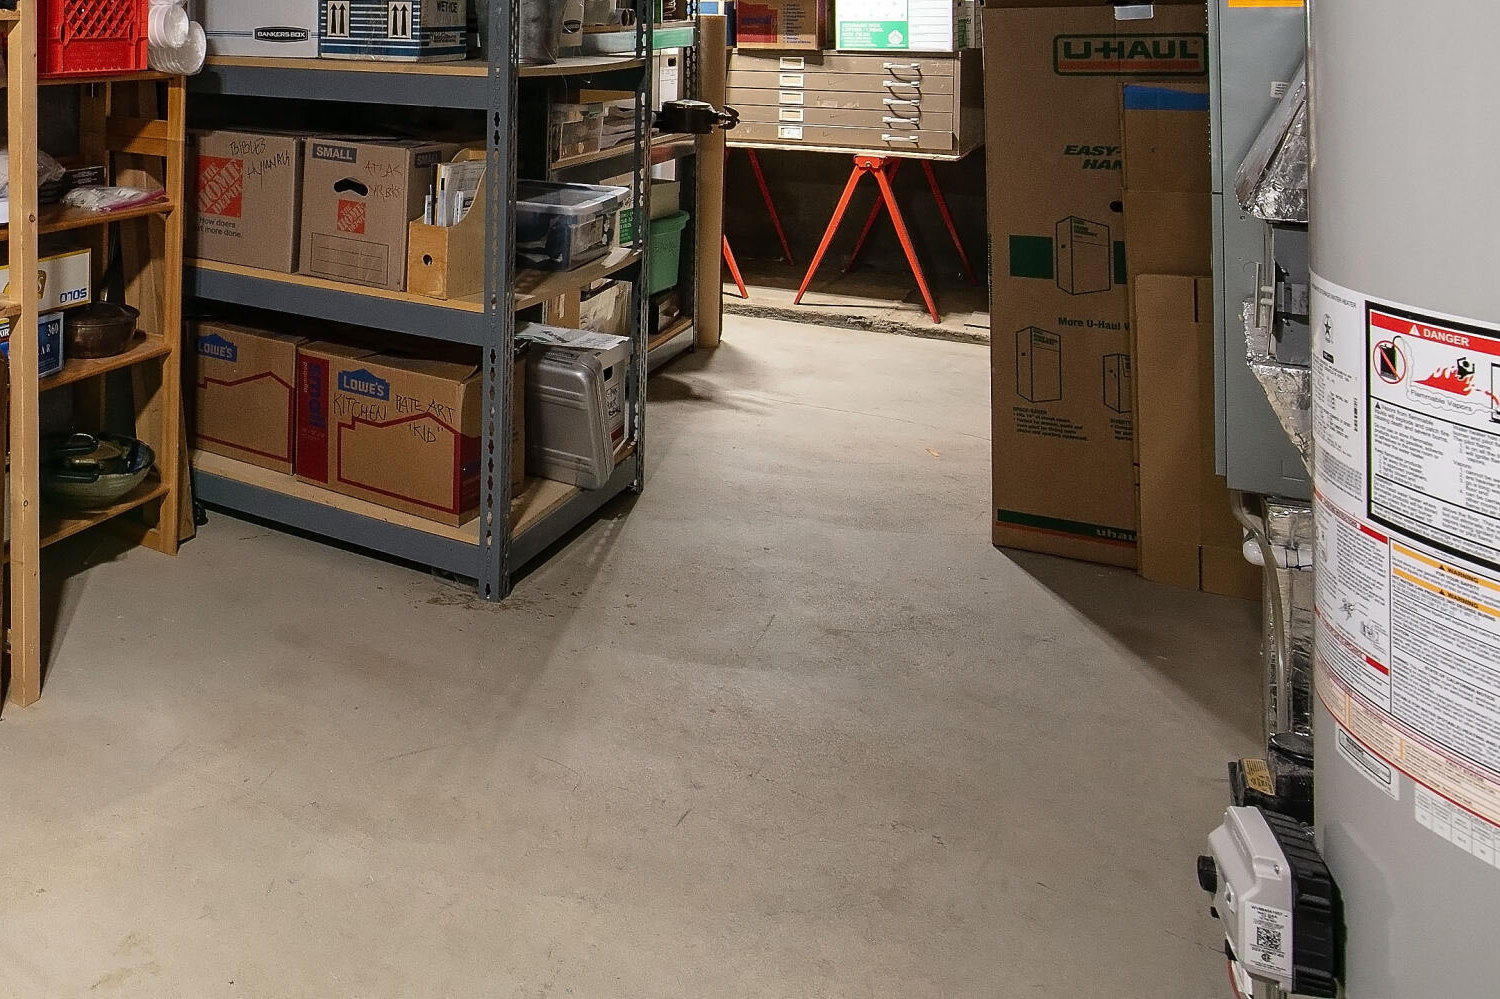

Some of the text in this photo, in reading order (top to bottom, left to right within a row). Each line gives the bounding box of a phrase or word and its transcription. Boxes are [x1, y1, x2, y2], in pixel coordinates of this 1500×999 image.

[257, 30, 289, 38] BANKERS
[1063, 40, 1199, 60] U-HAUL
[316, 147, 353, 160] SMALL
[1064, 145, 1122, 156] EASY-
[1082, 159, 1122, 170] HAN
[197, 158, 242, 212] HOME
[205, 226, 222, 235] more
[60, 288, 87, 303] SOLO
[47, 321, 58, 337] 360
[1058, 317, 1121, 331] More U-Haul
[1423, 328, 1469, 347] DANGER
[200, 342, 233, 359] OWE'S
[343, 377, 385, 397] LOWE'S
[333, 392, 387, 421] KITCHEN
[426, 399, 455, 423] ART
[1410, 389, 1473, 412] Flammable Vapors
[1096, 528, 1136, 541] uhau
[1447, 566, 1479, 584] WARNING
[1447, 591, 1479, 609] WARNING
